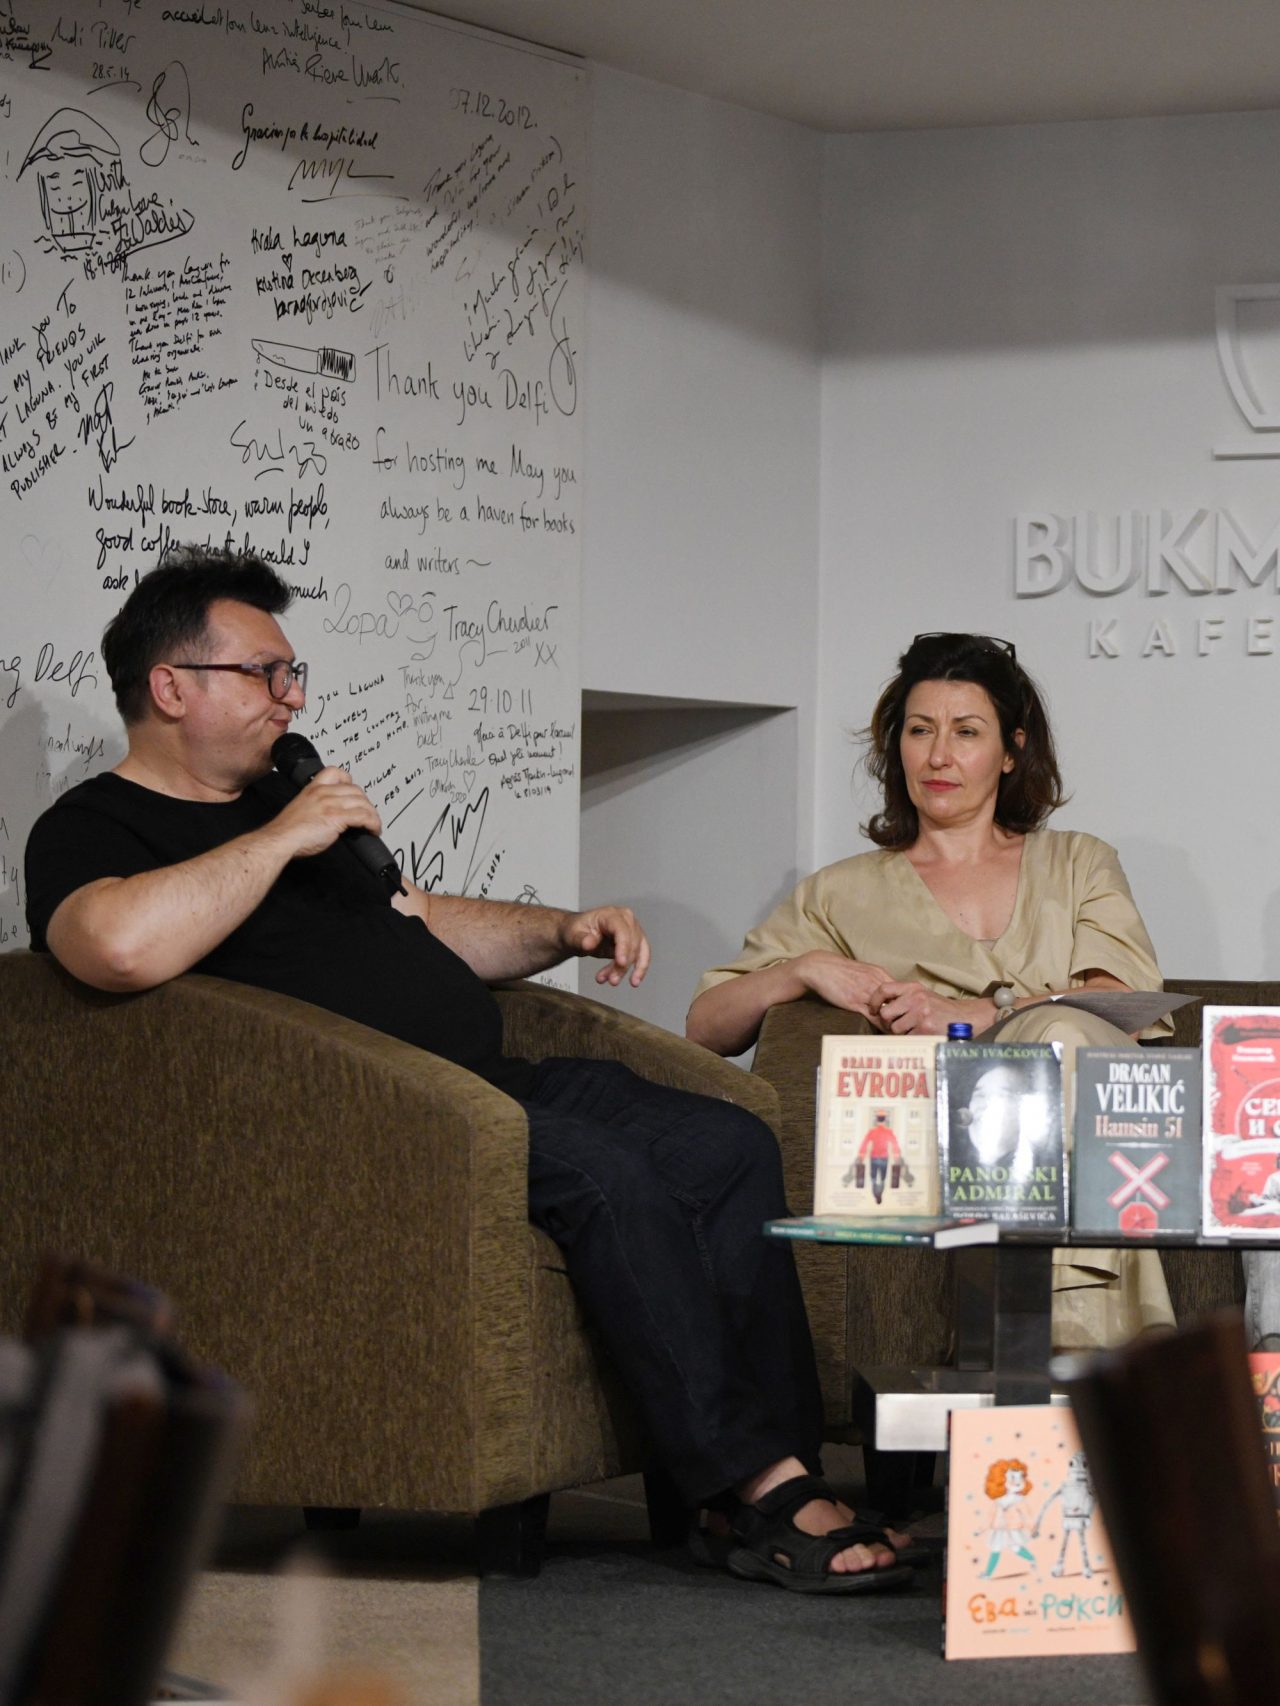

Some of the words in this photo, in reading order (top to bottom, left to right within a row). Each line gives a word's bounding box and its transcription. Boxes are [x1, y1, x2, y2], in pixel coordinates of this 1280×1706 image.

[263, 368, 299, 394] Desde
[364, 342, 440, 402] Thank
[452, 379, 493, 426] you
[498, 368, 550, 426] Delfi
[405, 441, 466, 490] hosting
[475, 455, 499, 476] me
[510, 444, 545, 499] May
[88, 473, 156, 529] Wonderful
[243, 496, 285, 517] warm
[379, 498, 431, 536] always
[436, 497, 454, 522] be
[459, 507, 471, 522] a
[476, 496, 515, 526] haven
[95, 526, 135, 571] good
[260, 538, 296, 566] could
[384, 549, 411, 571] and
[101, 564, 130, 591] ask
[442, 603, 488, 668] Tracy
[34, 641, 98, 698] Delfi
[841, 1056, 882, 1069] GRAND
[1109, 1063, 1171, 1083] DRAGAN
[836, 1071, 930, 1099] EVROPA
[1095, 1079, 1186, 1114] VELIKIĆ
[1095, 1115, 1159, 1138] Hamsin
[952, 1184, 1056, 1202] ADMIRAL
[967, 1593, 1019, 1624] Ева
